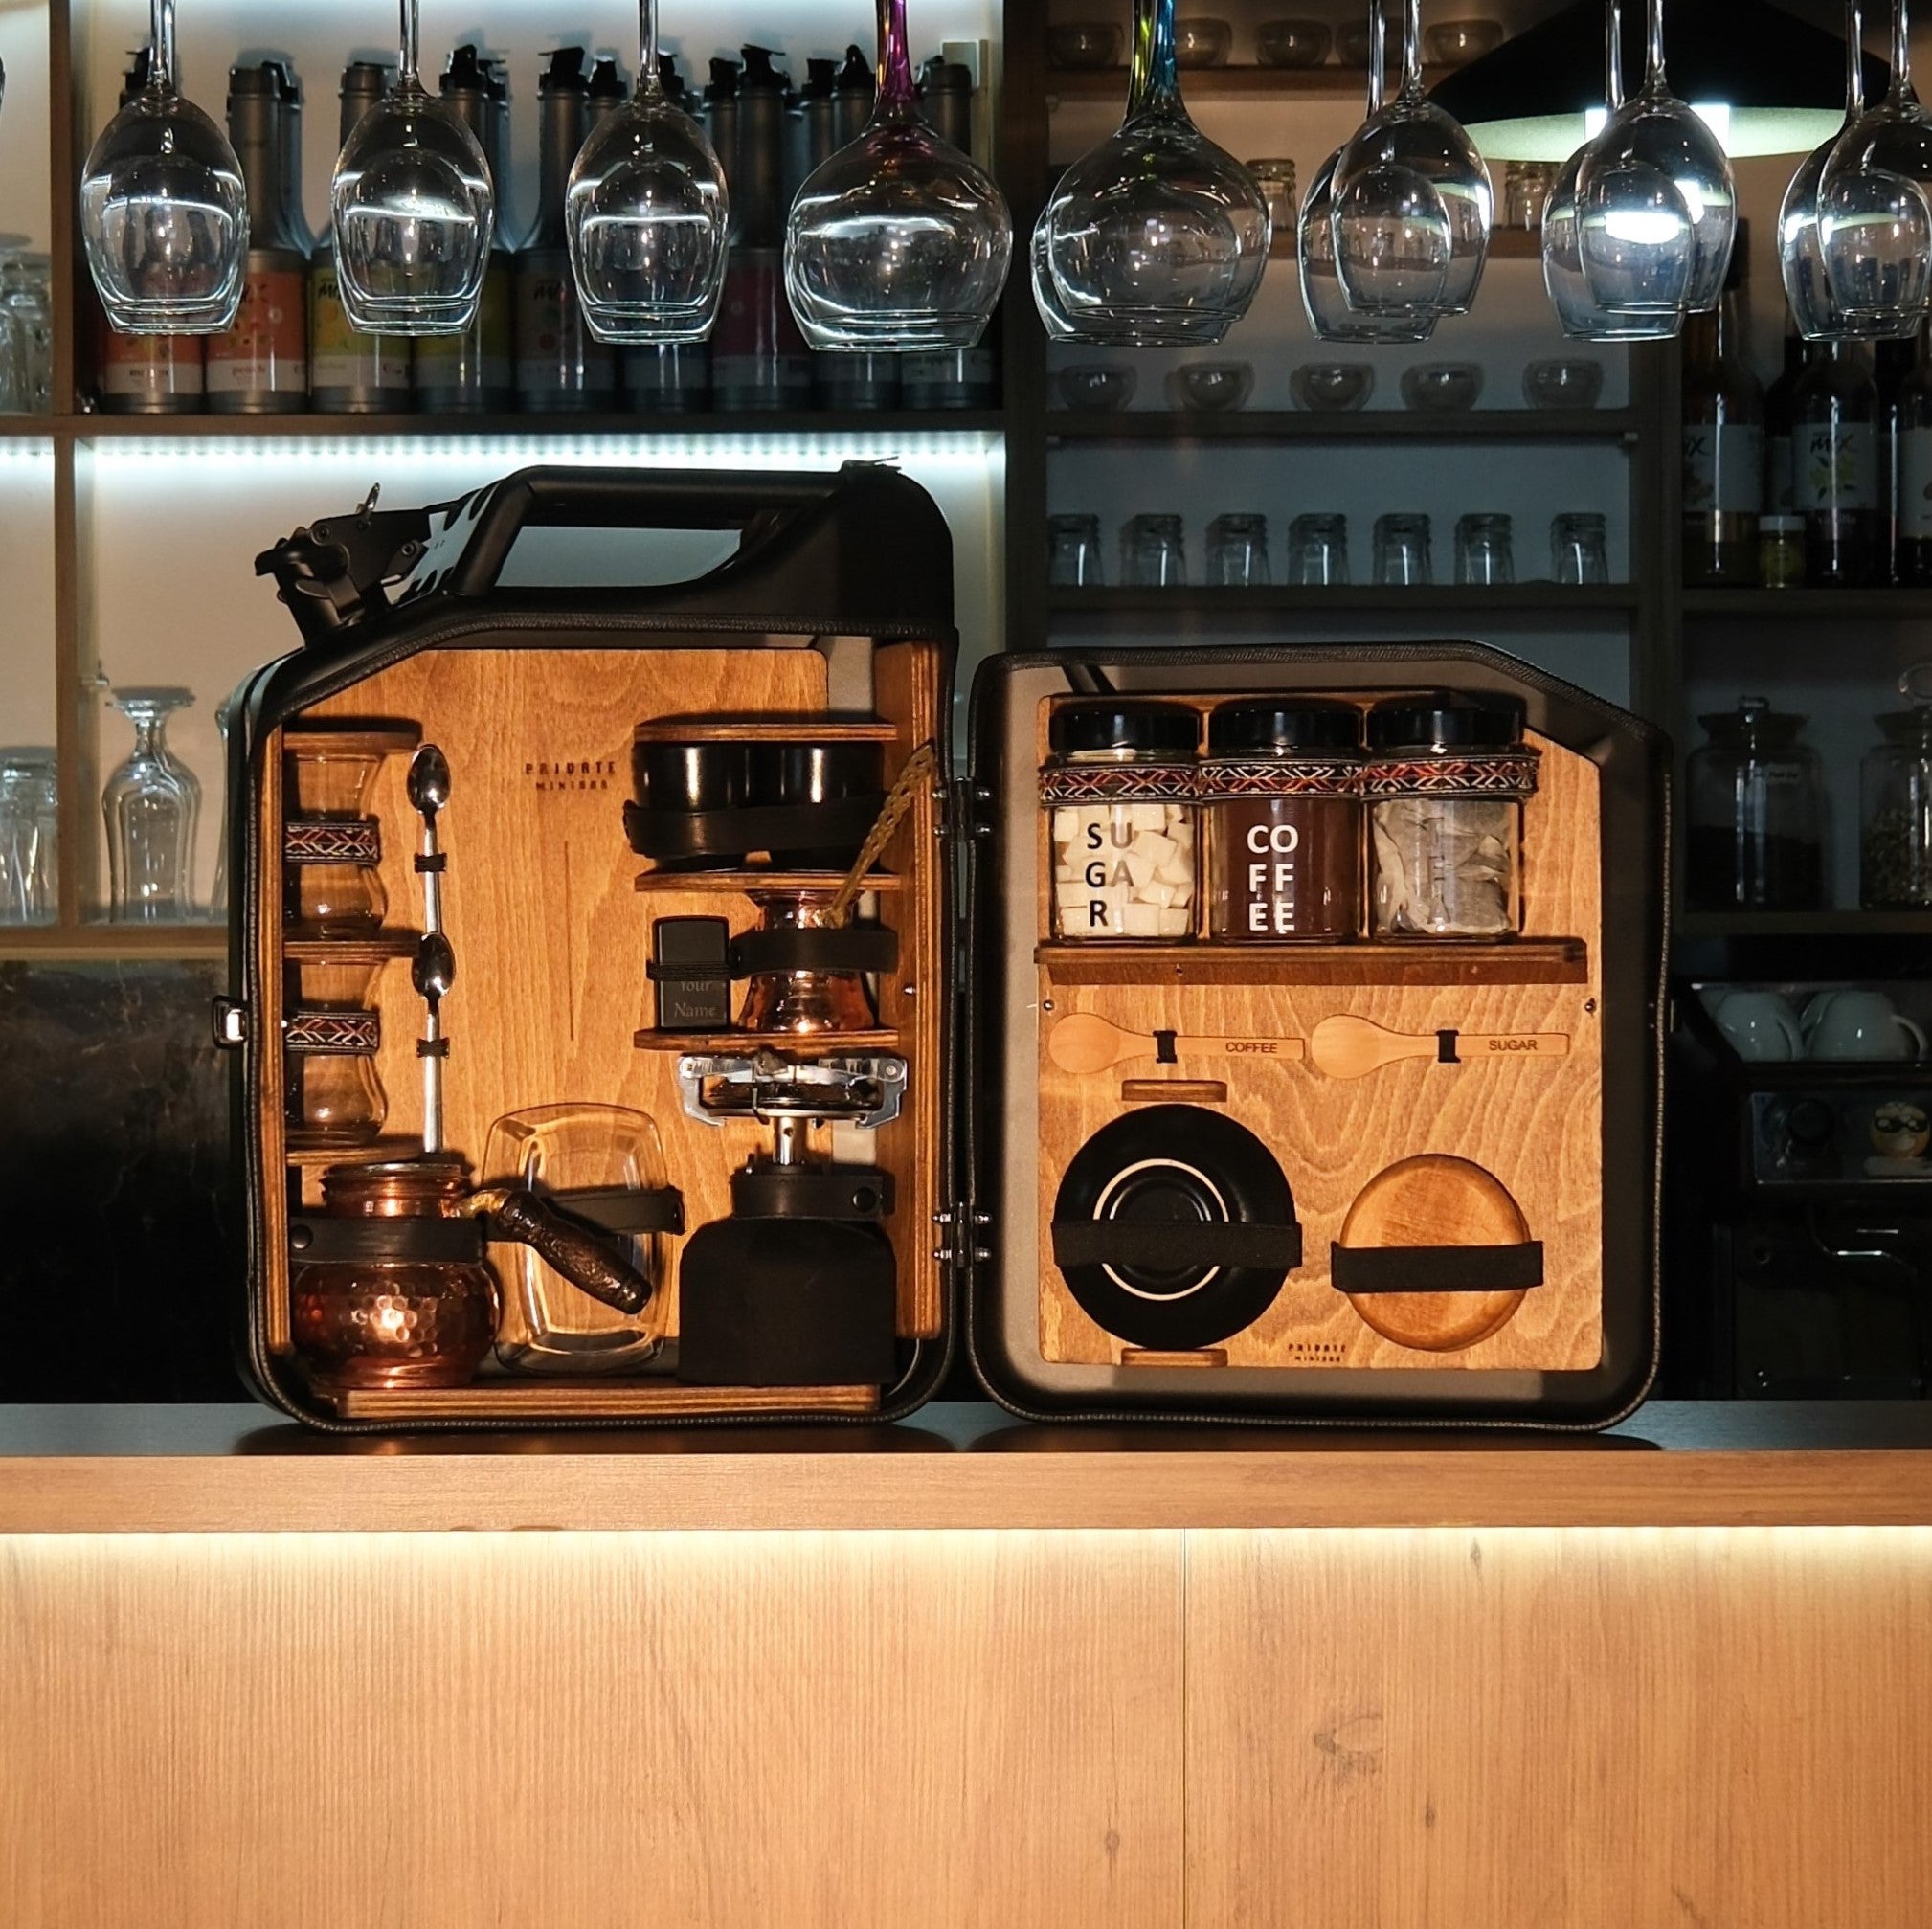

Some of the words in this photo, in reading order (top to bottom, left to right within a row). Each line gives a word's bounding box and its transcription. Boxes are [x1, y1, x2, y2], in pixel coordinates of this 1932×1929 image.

[1086, 821, 1133, 850] SU
[1247, 824, 1299, 854] CO
[1085, 860, 1134, 888] GA
[1248, 864, 1294, 892] FF
[1089, 899, 1109, 927] R
[1248, 902, 1295, 931] EE
[673, 1000, 718, 1018] Name
[1224, 1042, 1279, 1054] COFFEE
[1488, 1039, 1538, 1051] SUGAR
